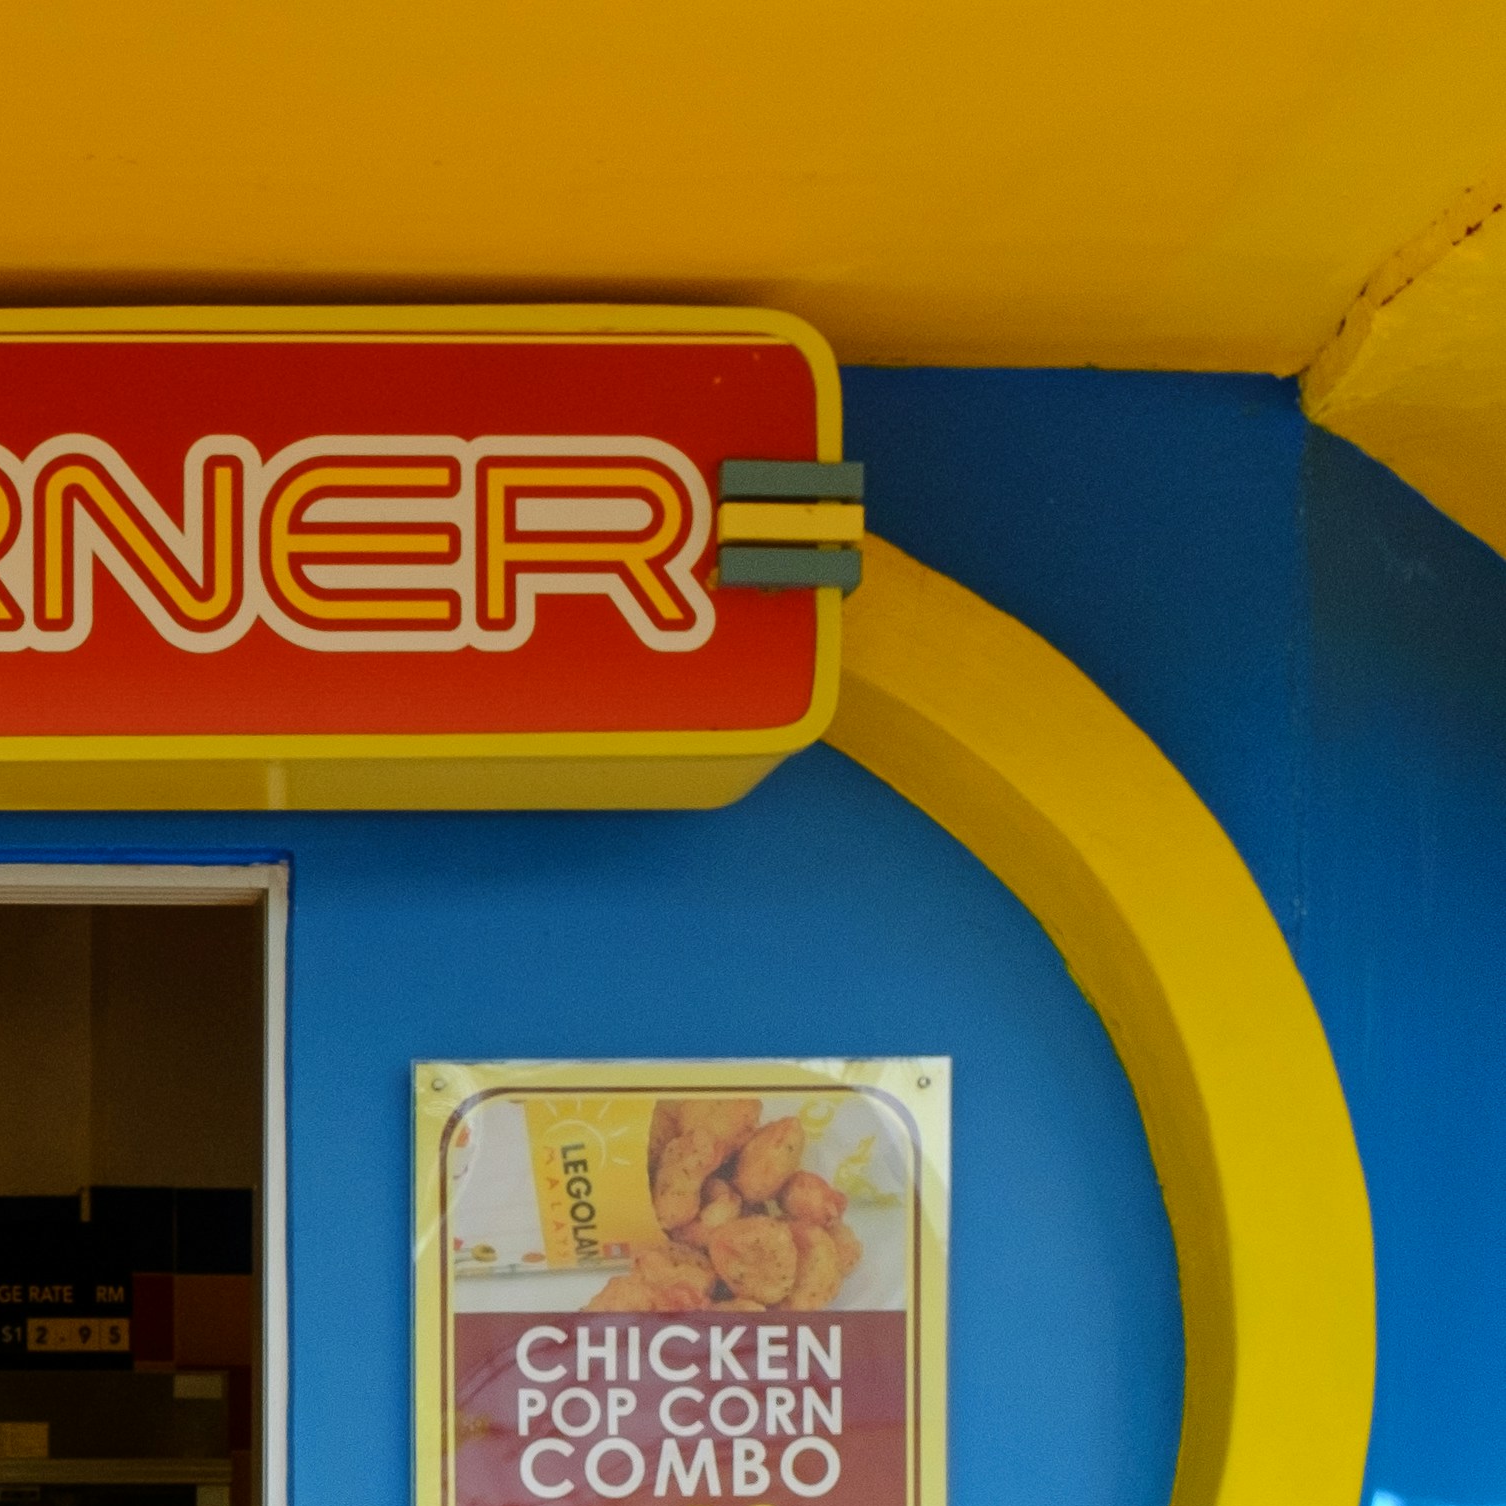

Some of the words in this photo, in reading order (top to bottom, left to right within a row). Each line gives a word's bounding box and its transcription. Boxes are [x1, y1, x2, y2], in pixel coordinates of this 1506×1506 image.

[29, 1285, 74, 1302] RATE
[95, 1286, 125, 1302] RM
[1, 1325, 22, 1343] $1
[515, 1324, 843, 1382] CHICKEN
[518, 1387, 638, 1437] POP
[659, 1386, 843, 1437] CORN
[519, 1437, 841, 1498] COMBO
